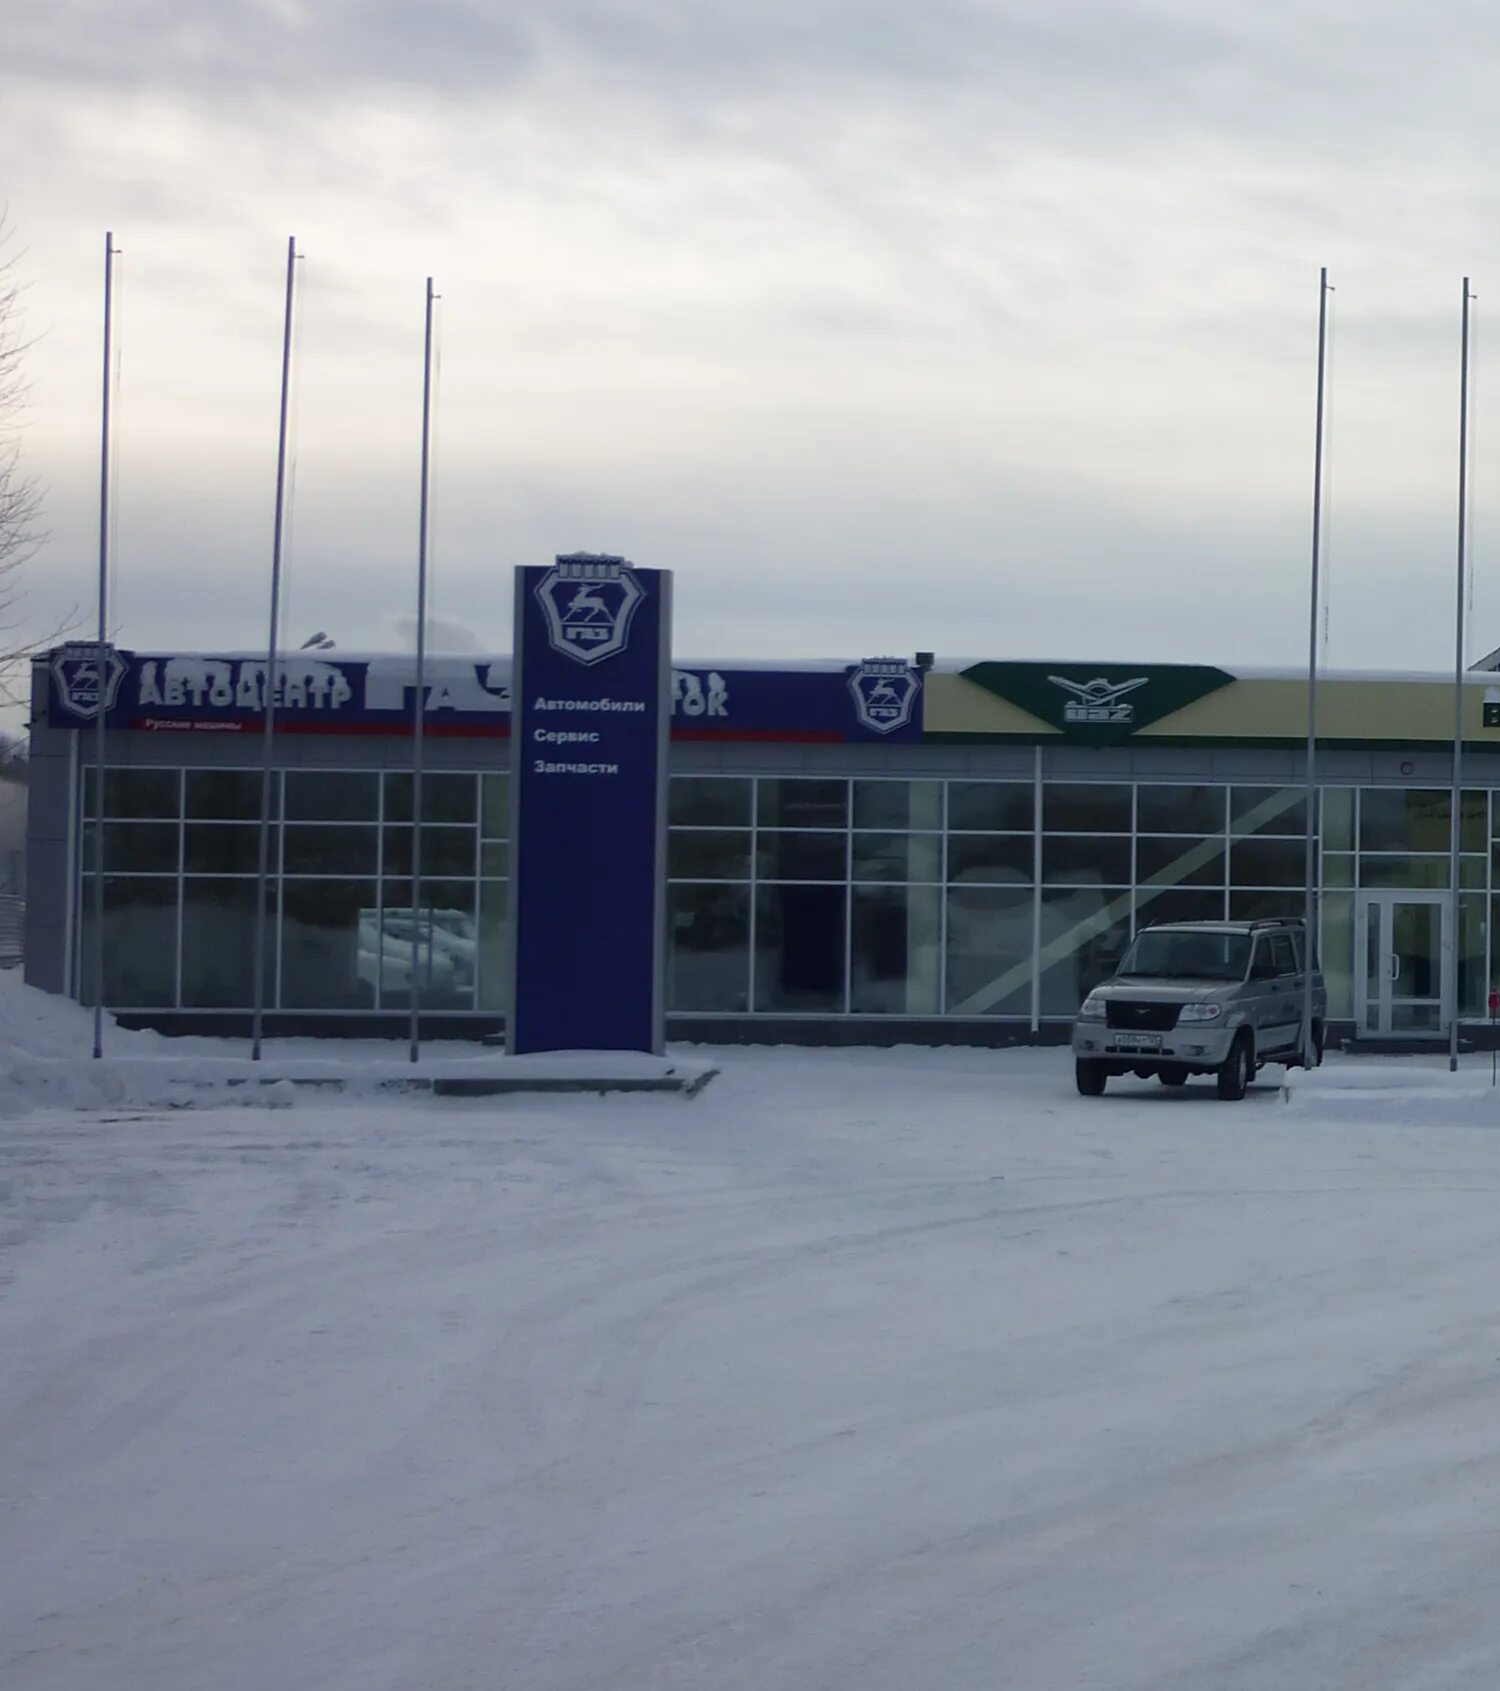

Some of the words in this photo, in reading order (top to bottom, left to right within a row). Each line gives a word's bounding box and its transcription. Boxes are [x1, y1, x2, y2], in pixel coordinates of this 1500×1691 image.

[534, 697, 646, 712] Автомобили
[534, 729, 600, 744] Сервис
[534, 760, 619, 774] Запчасти
